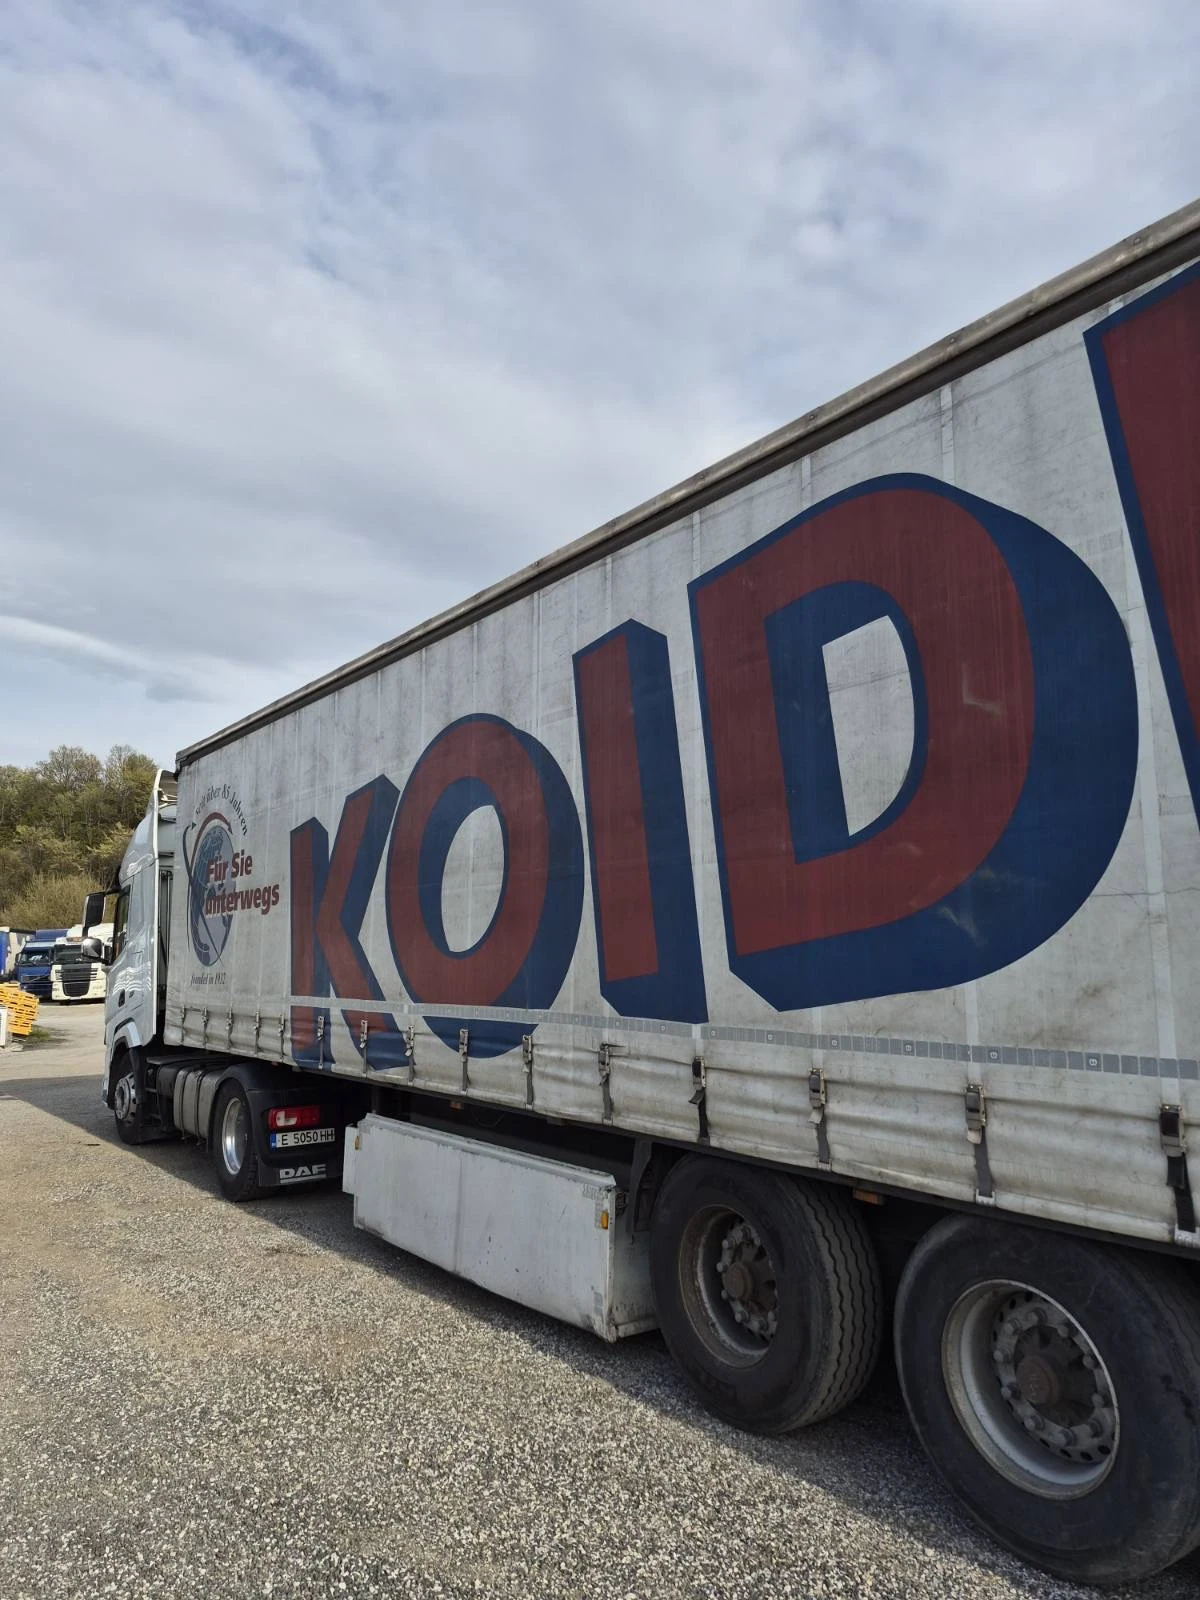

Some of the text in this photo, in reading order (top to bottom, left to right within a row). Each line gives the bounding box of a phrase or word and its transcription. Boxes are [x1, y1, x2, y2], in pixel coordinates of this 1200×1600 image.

[290, 260, 1200, 1071] KOID
[229, 791, 248, 836] Jahren
[207, 849, 253, 883] Für Sie
[205, 883, 280, 916] unterwegs
[281, 1134, 289, 1146] E
[280, 1164, 326, 1181] DAF
